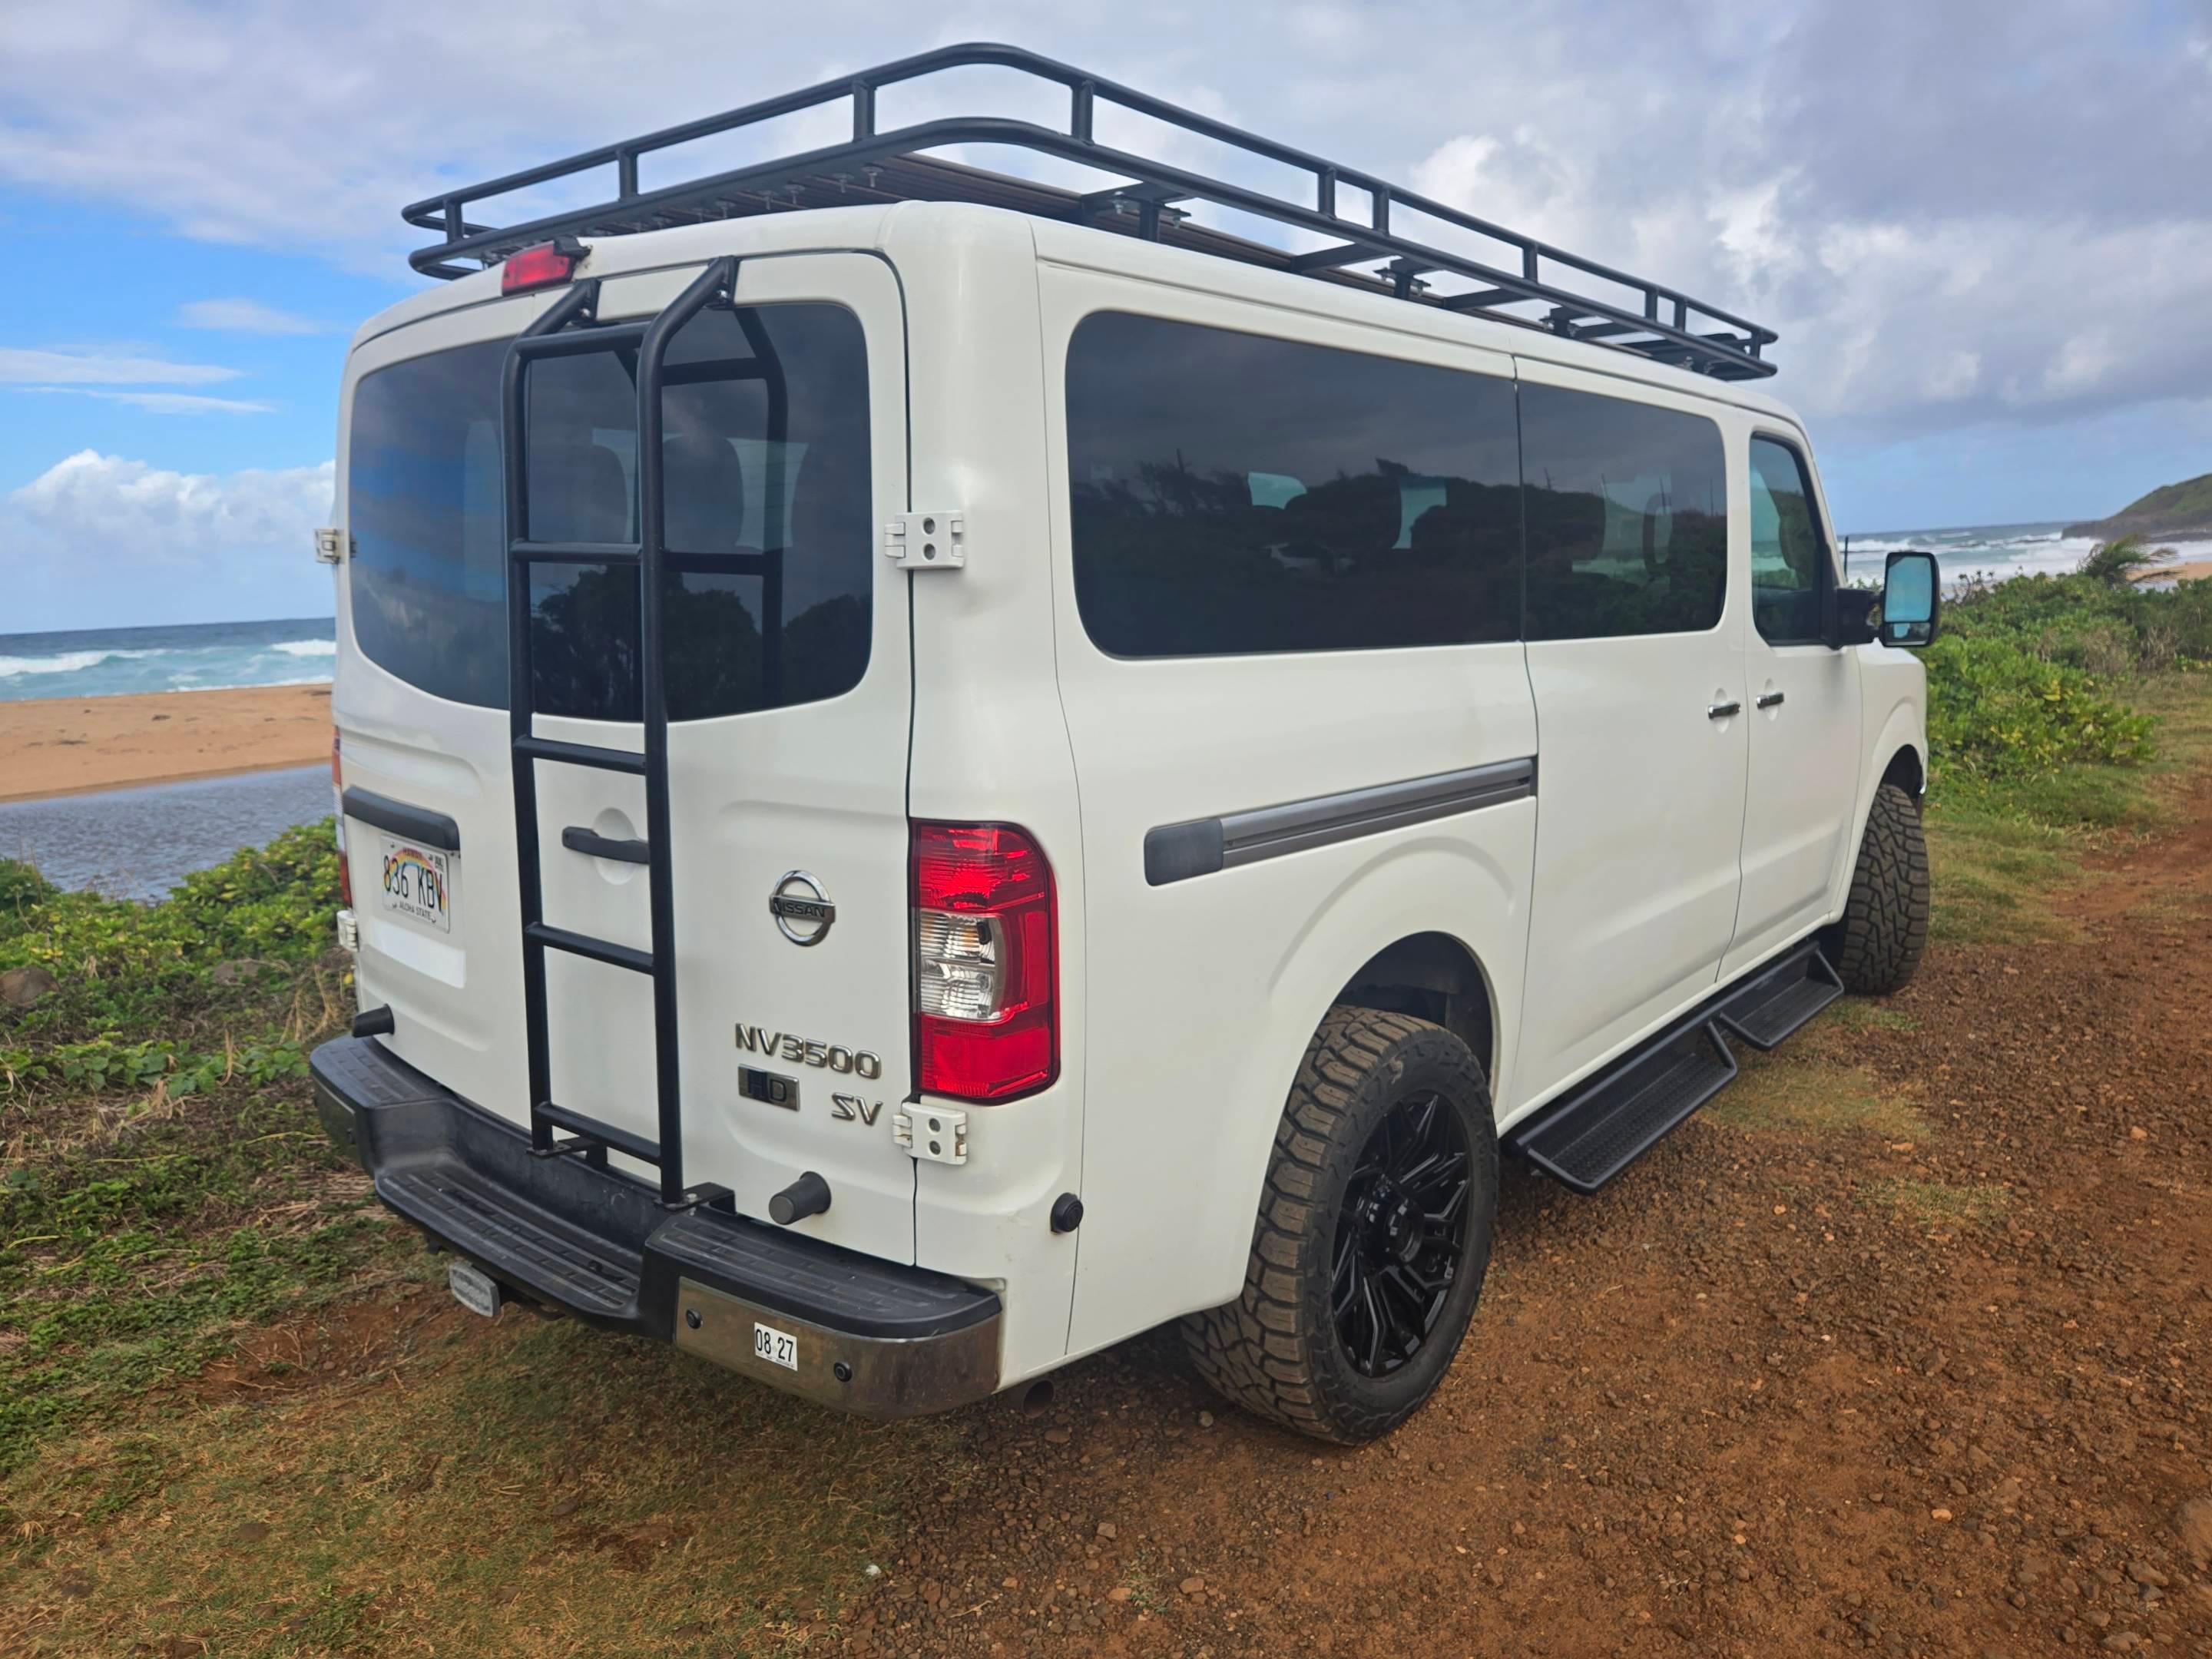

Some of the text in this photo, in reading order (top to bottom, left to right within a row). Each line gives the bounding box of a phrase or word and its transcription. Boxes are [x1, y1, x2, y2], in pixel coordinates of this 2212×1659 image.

[384, 855, 409, 898] 836
[773, 899, 825, 917] NISSAN
[735, 1022, 882, 1080] NV3500
[747, 1068, 787, 1103] HD
[831, 1091, 883, 1127] SV
[756, 1329, 771, 1354] 08
[777, 1336, 793, 1362] 27
